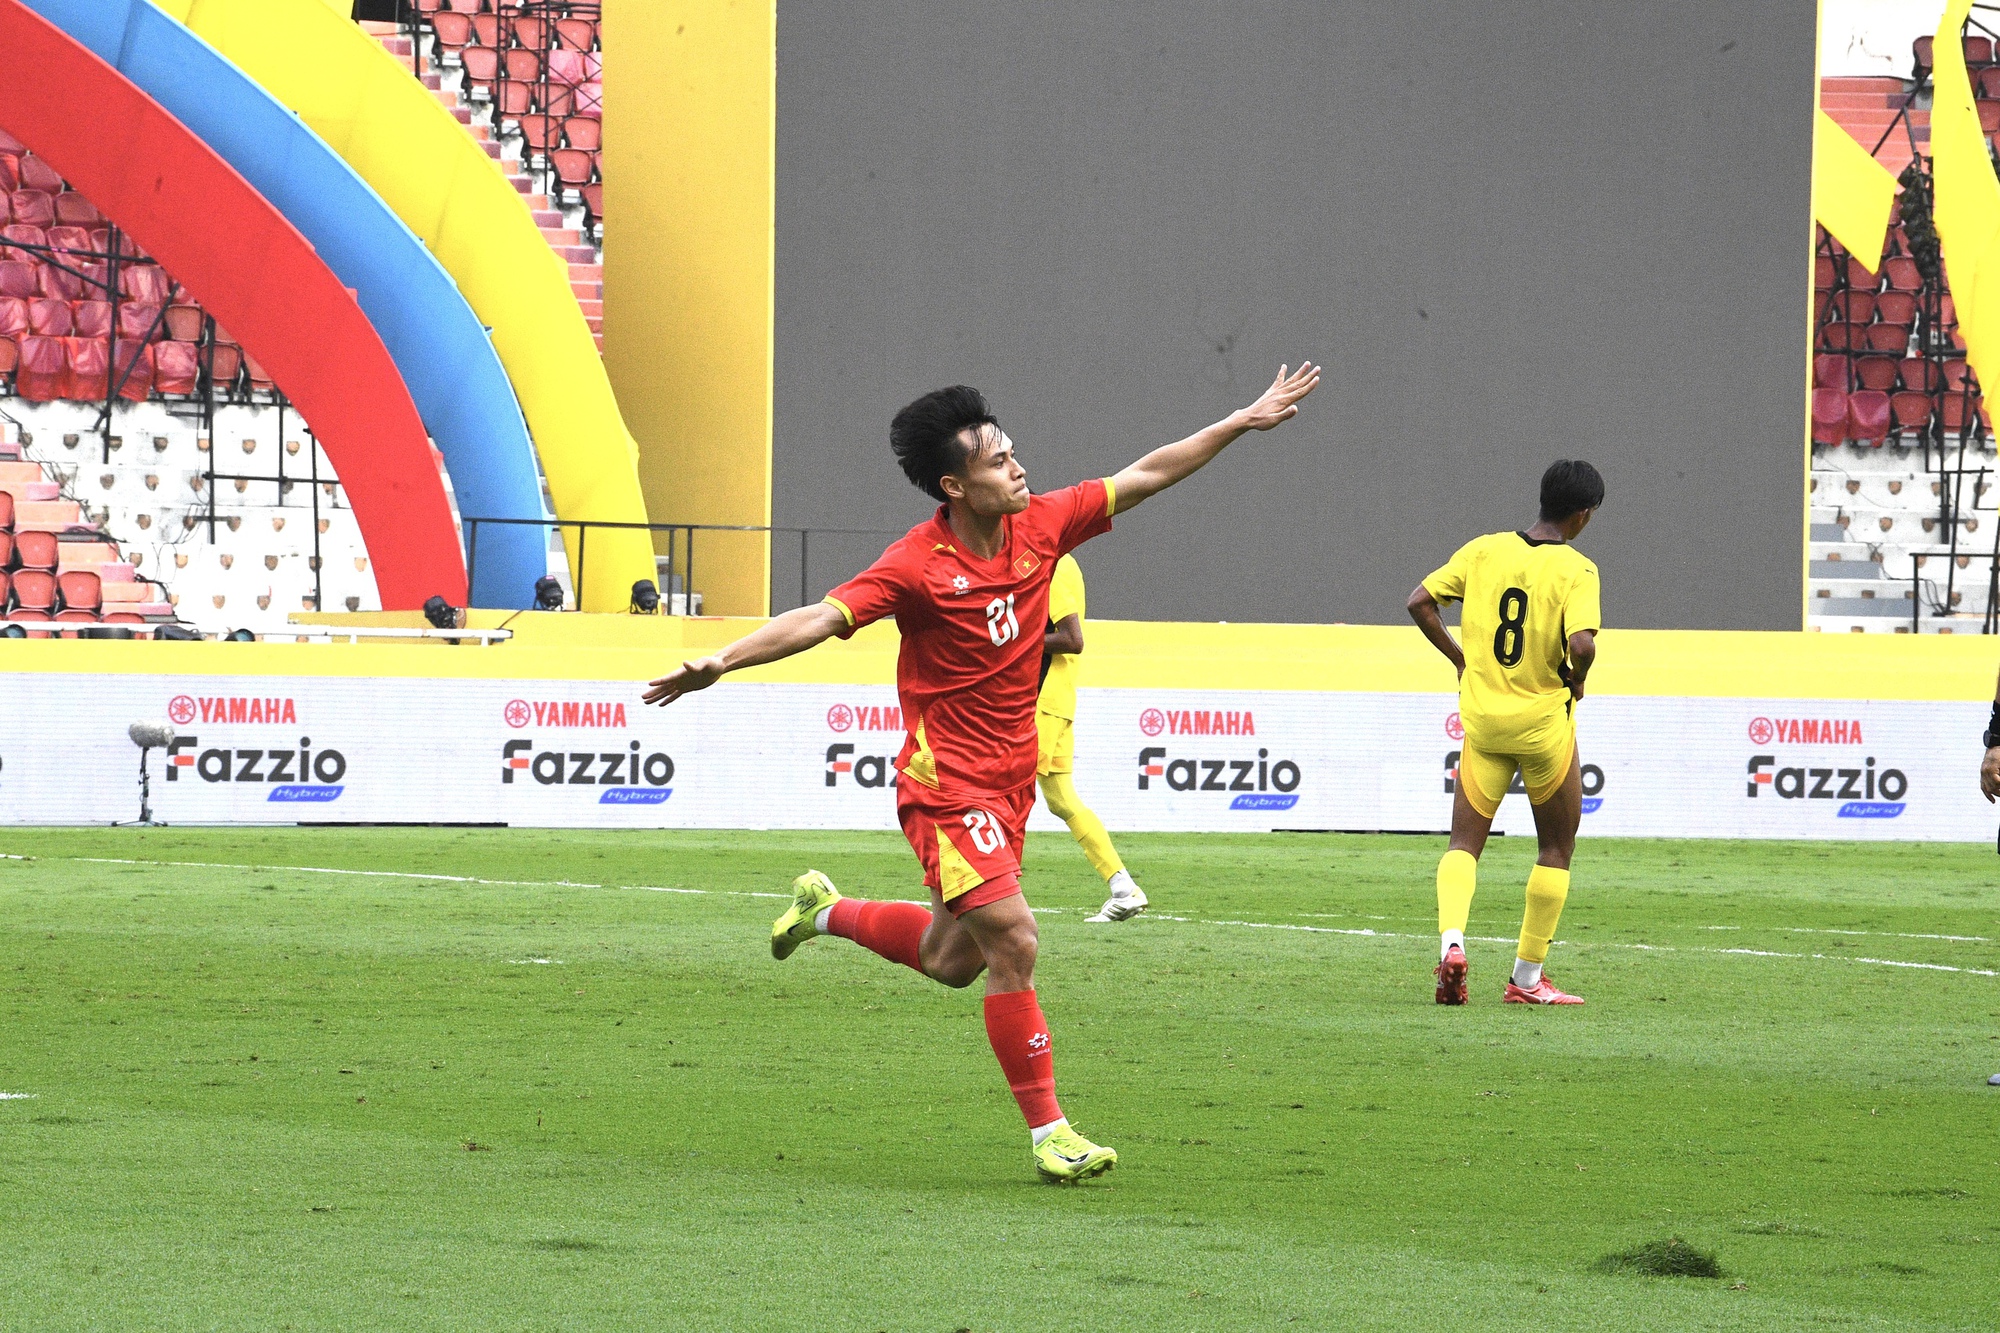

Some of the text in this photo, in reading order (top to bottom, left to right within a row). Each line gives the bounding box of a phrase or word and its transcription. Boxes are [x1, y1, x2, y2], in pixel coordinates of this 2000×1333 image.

[986, 592, 1019, 647] 21
[1493, 587, 1529, 670] 8
[199, 698, 296, 723] YAMAHA
[533, 702, 627, 728] YAMAHA
[1167, 711, 1255, 735] YAMAHA
[1775, 719, 1862, 744] YAMAHA
[166, 736, 346, 783] Fazzio
[502, 739, 675, 786] Fazzio
[1138, 747, 1301, 792] Fazzio
[1747, 755, 1908, 800] Fazzio
[275, 786, 338, 800] Hybrid
[607, 789, 667, 802] Hybrid
[1236, 794, 1294, 808] Hybrid
[1844, 803, 1900, 816] Hybrid
[961, 808, 1007, 855] 21
